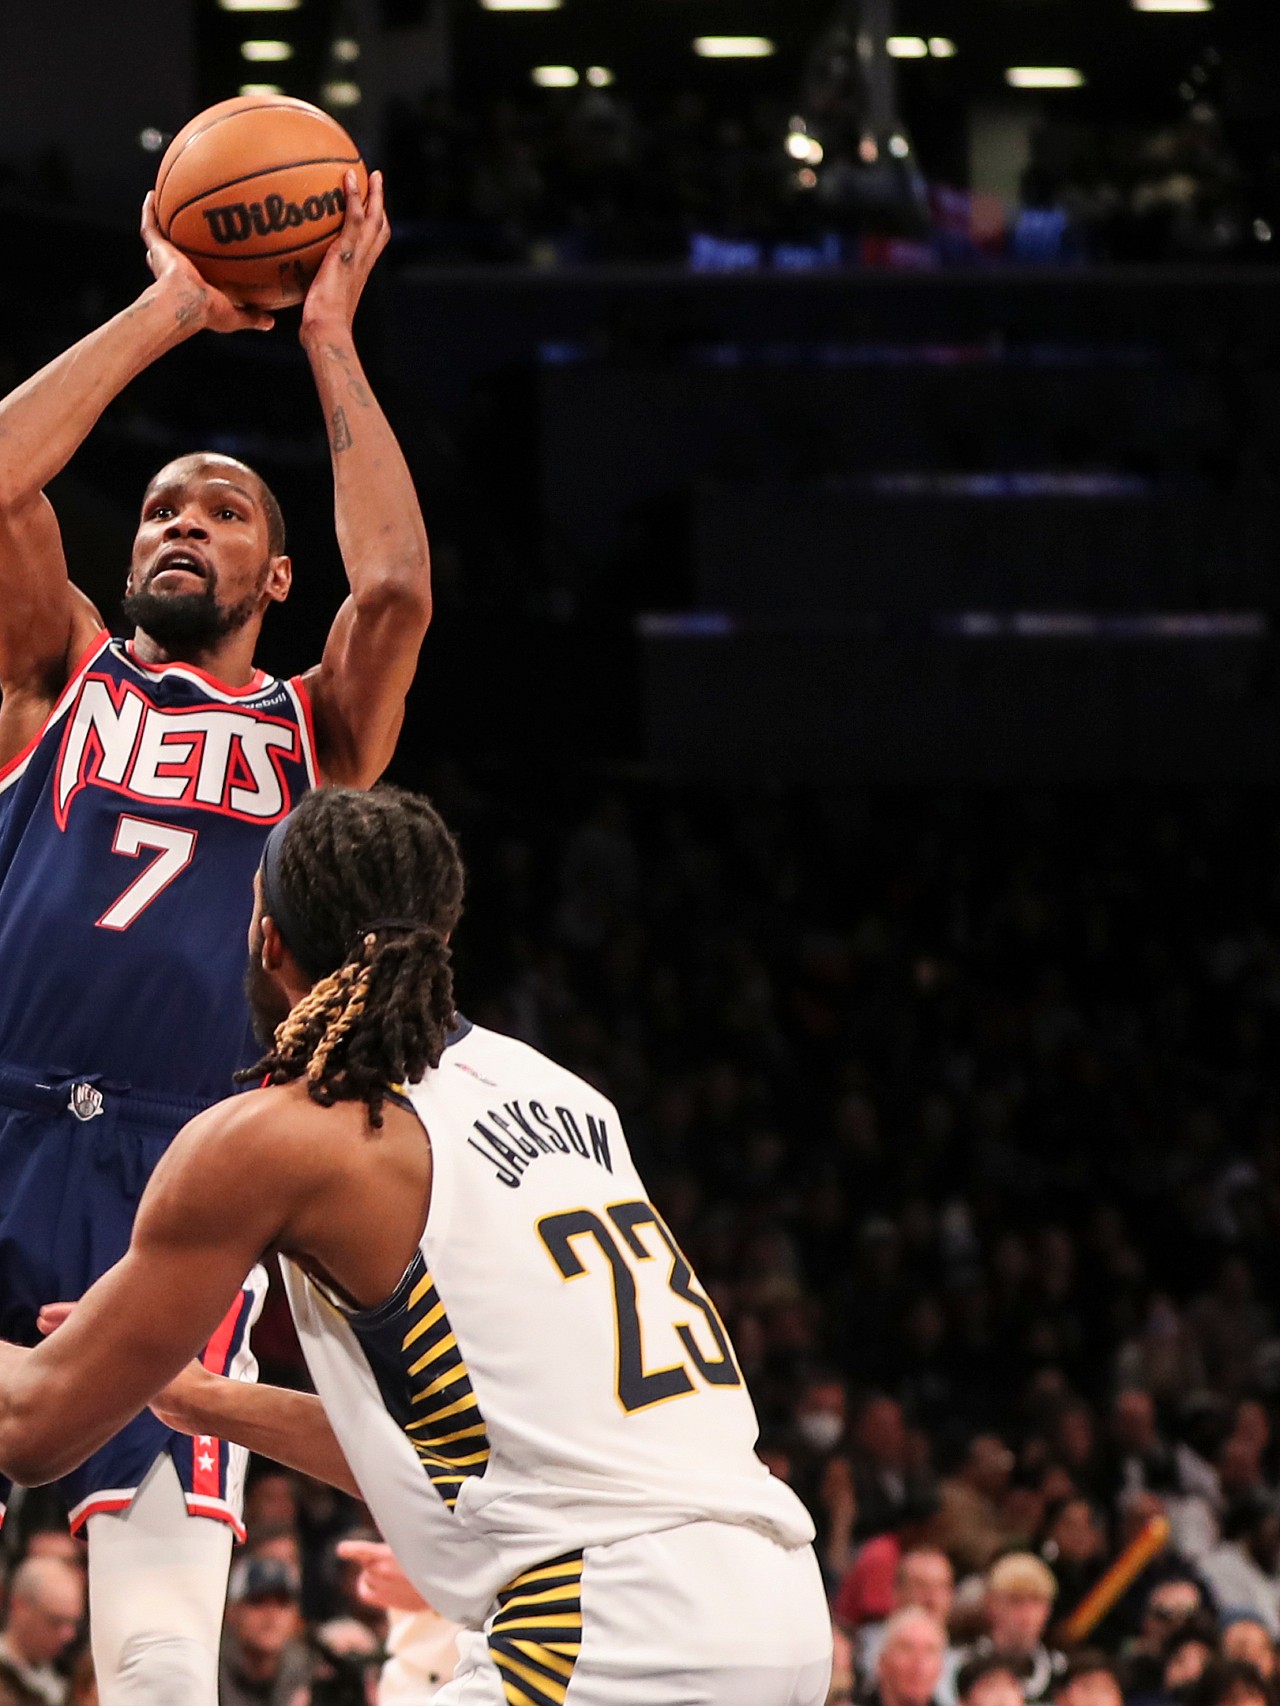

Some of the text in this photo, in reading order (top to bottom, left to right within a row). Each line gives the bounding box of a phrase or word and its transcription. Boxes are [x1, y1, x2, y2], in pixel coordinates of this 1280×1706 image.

[203, 187, 345, 244] Wilson
[55, 674, 300, 828] NETS
[95, 813, 198, 931] 7
[467, 1099, 613, 1189] JACKSON
[534, 1199, 742, 1416] 23
